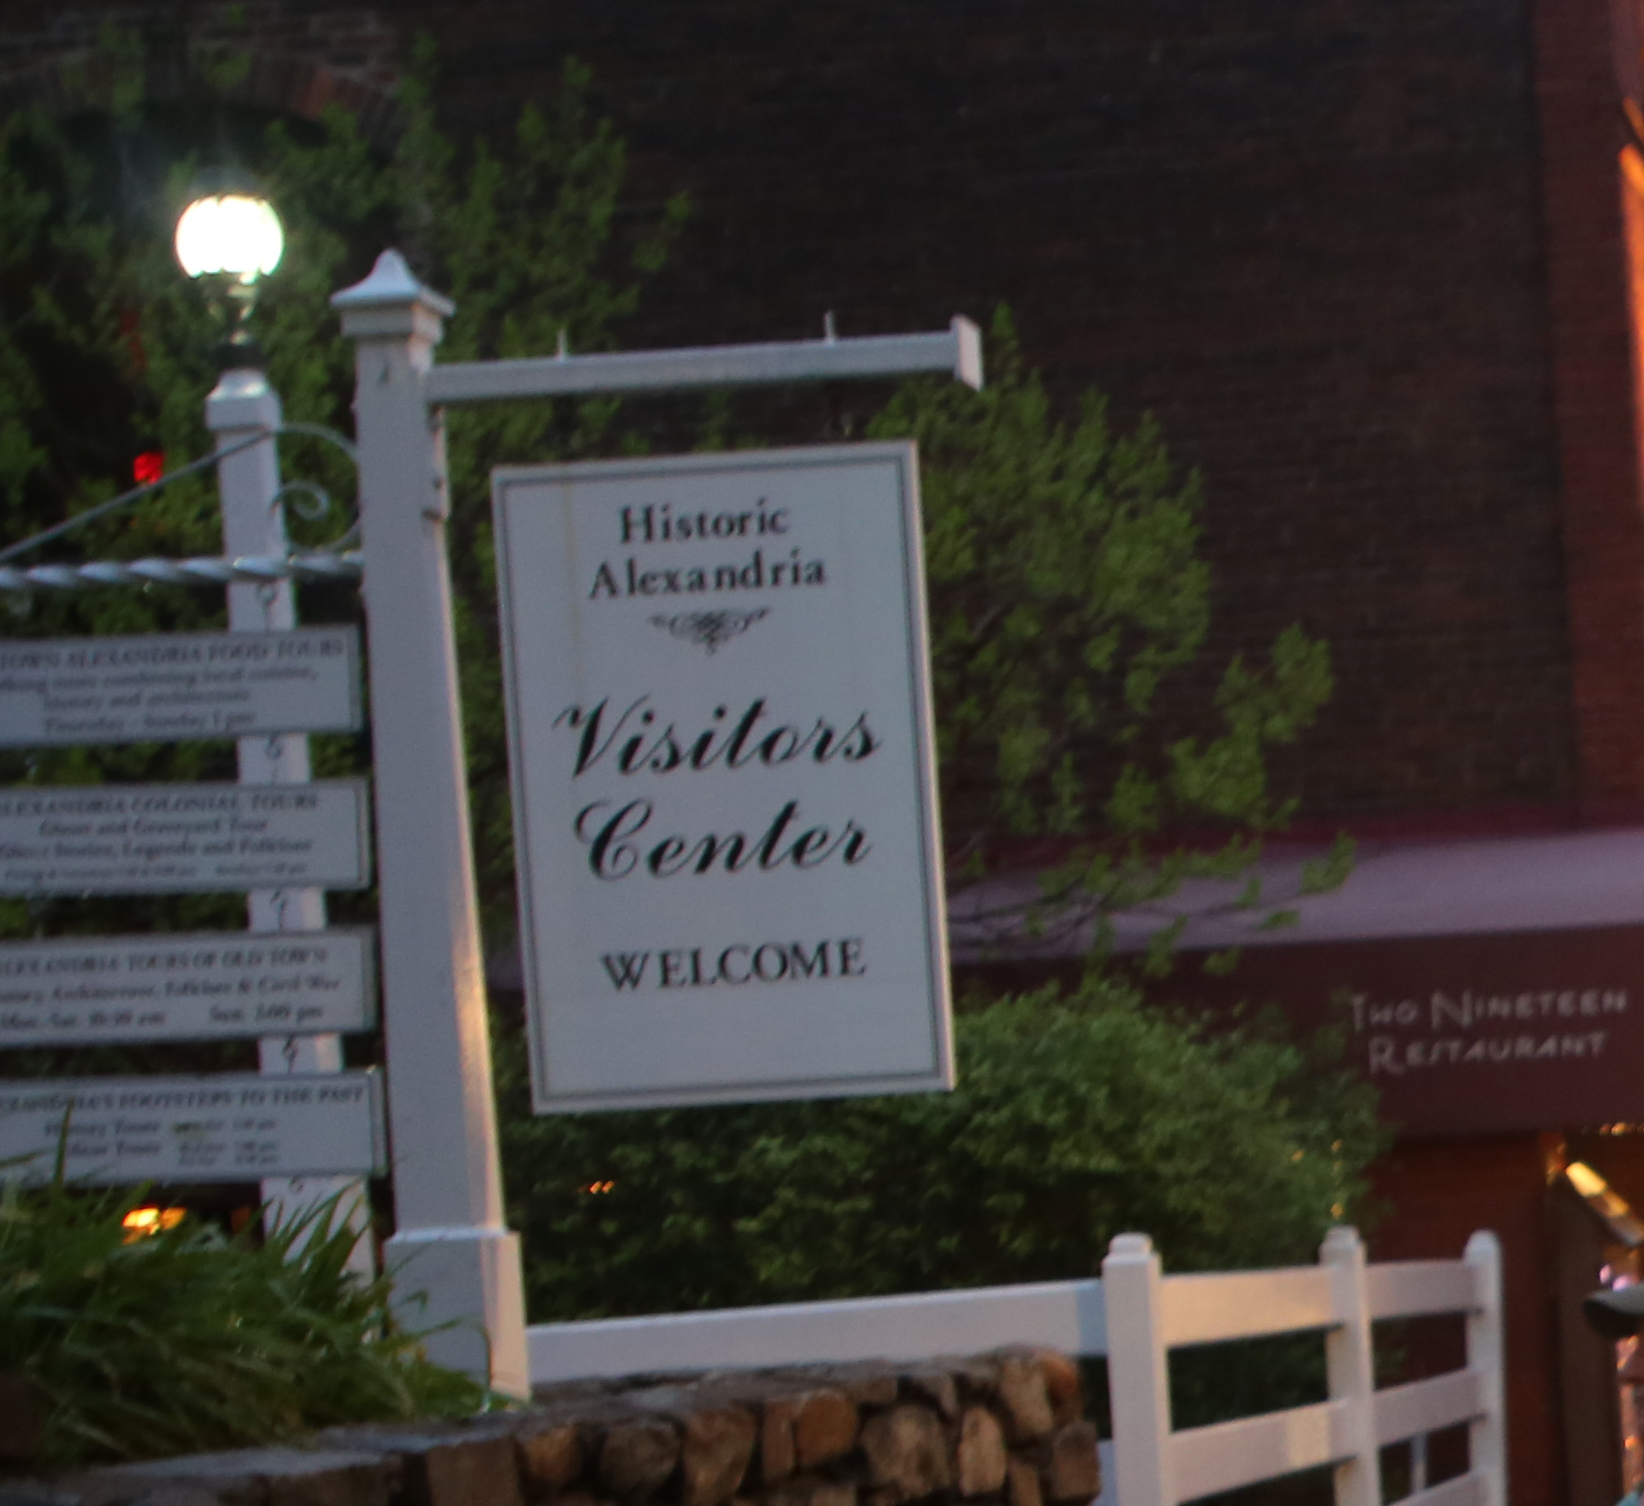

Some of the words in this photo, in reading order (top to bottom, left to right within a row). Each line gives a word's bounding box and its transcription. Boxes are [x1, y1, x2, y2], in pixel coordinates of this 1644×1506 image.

[619, 496, 790, 546] Historic
[589, 549, 828, 600] Alexandria
[551, 695, 882, 781] Visitors
[573, 799, 872, 882] Center
[601, 936, 867, 994] WELCOME
[1367, 1030, 1609, 1076] RESTAURANT
